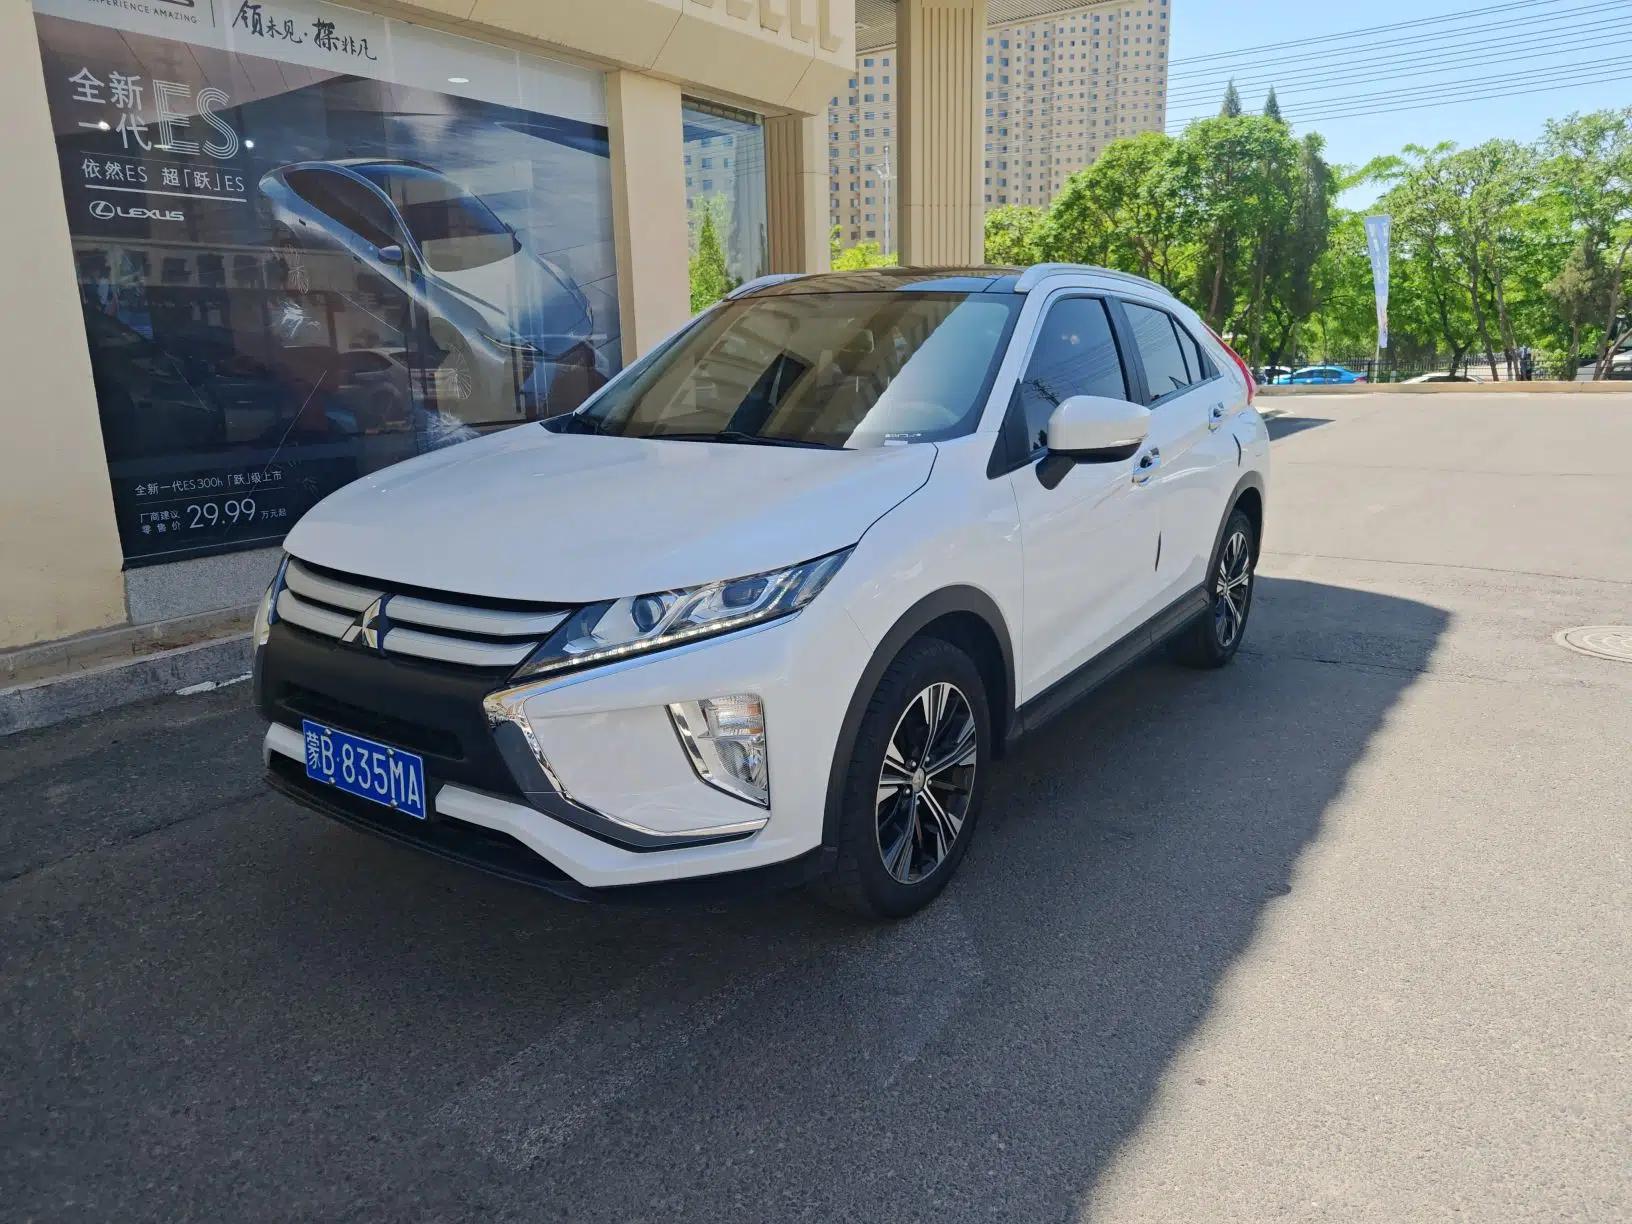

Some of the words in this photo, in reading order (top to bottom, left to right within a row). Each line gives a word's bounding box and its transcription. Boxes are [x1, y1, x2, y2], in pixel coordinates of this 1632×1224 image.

[153, 8, 199, 24] AMAZING
[68, 67, 143, 111] 全新
[78, 113, 152, 151] 一代
[152, 79, 239, 159] ES
[82, 158, 148, 183] 依然ES
[116, 206, 185, 221] LEXUS
[187, 498, 256, 529] 29.99
[261, 508, 287, 520] 万元起
